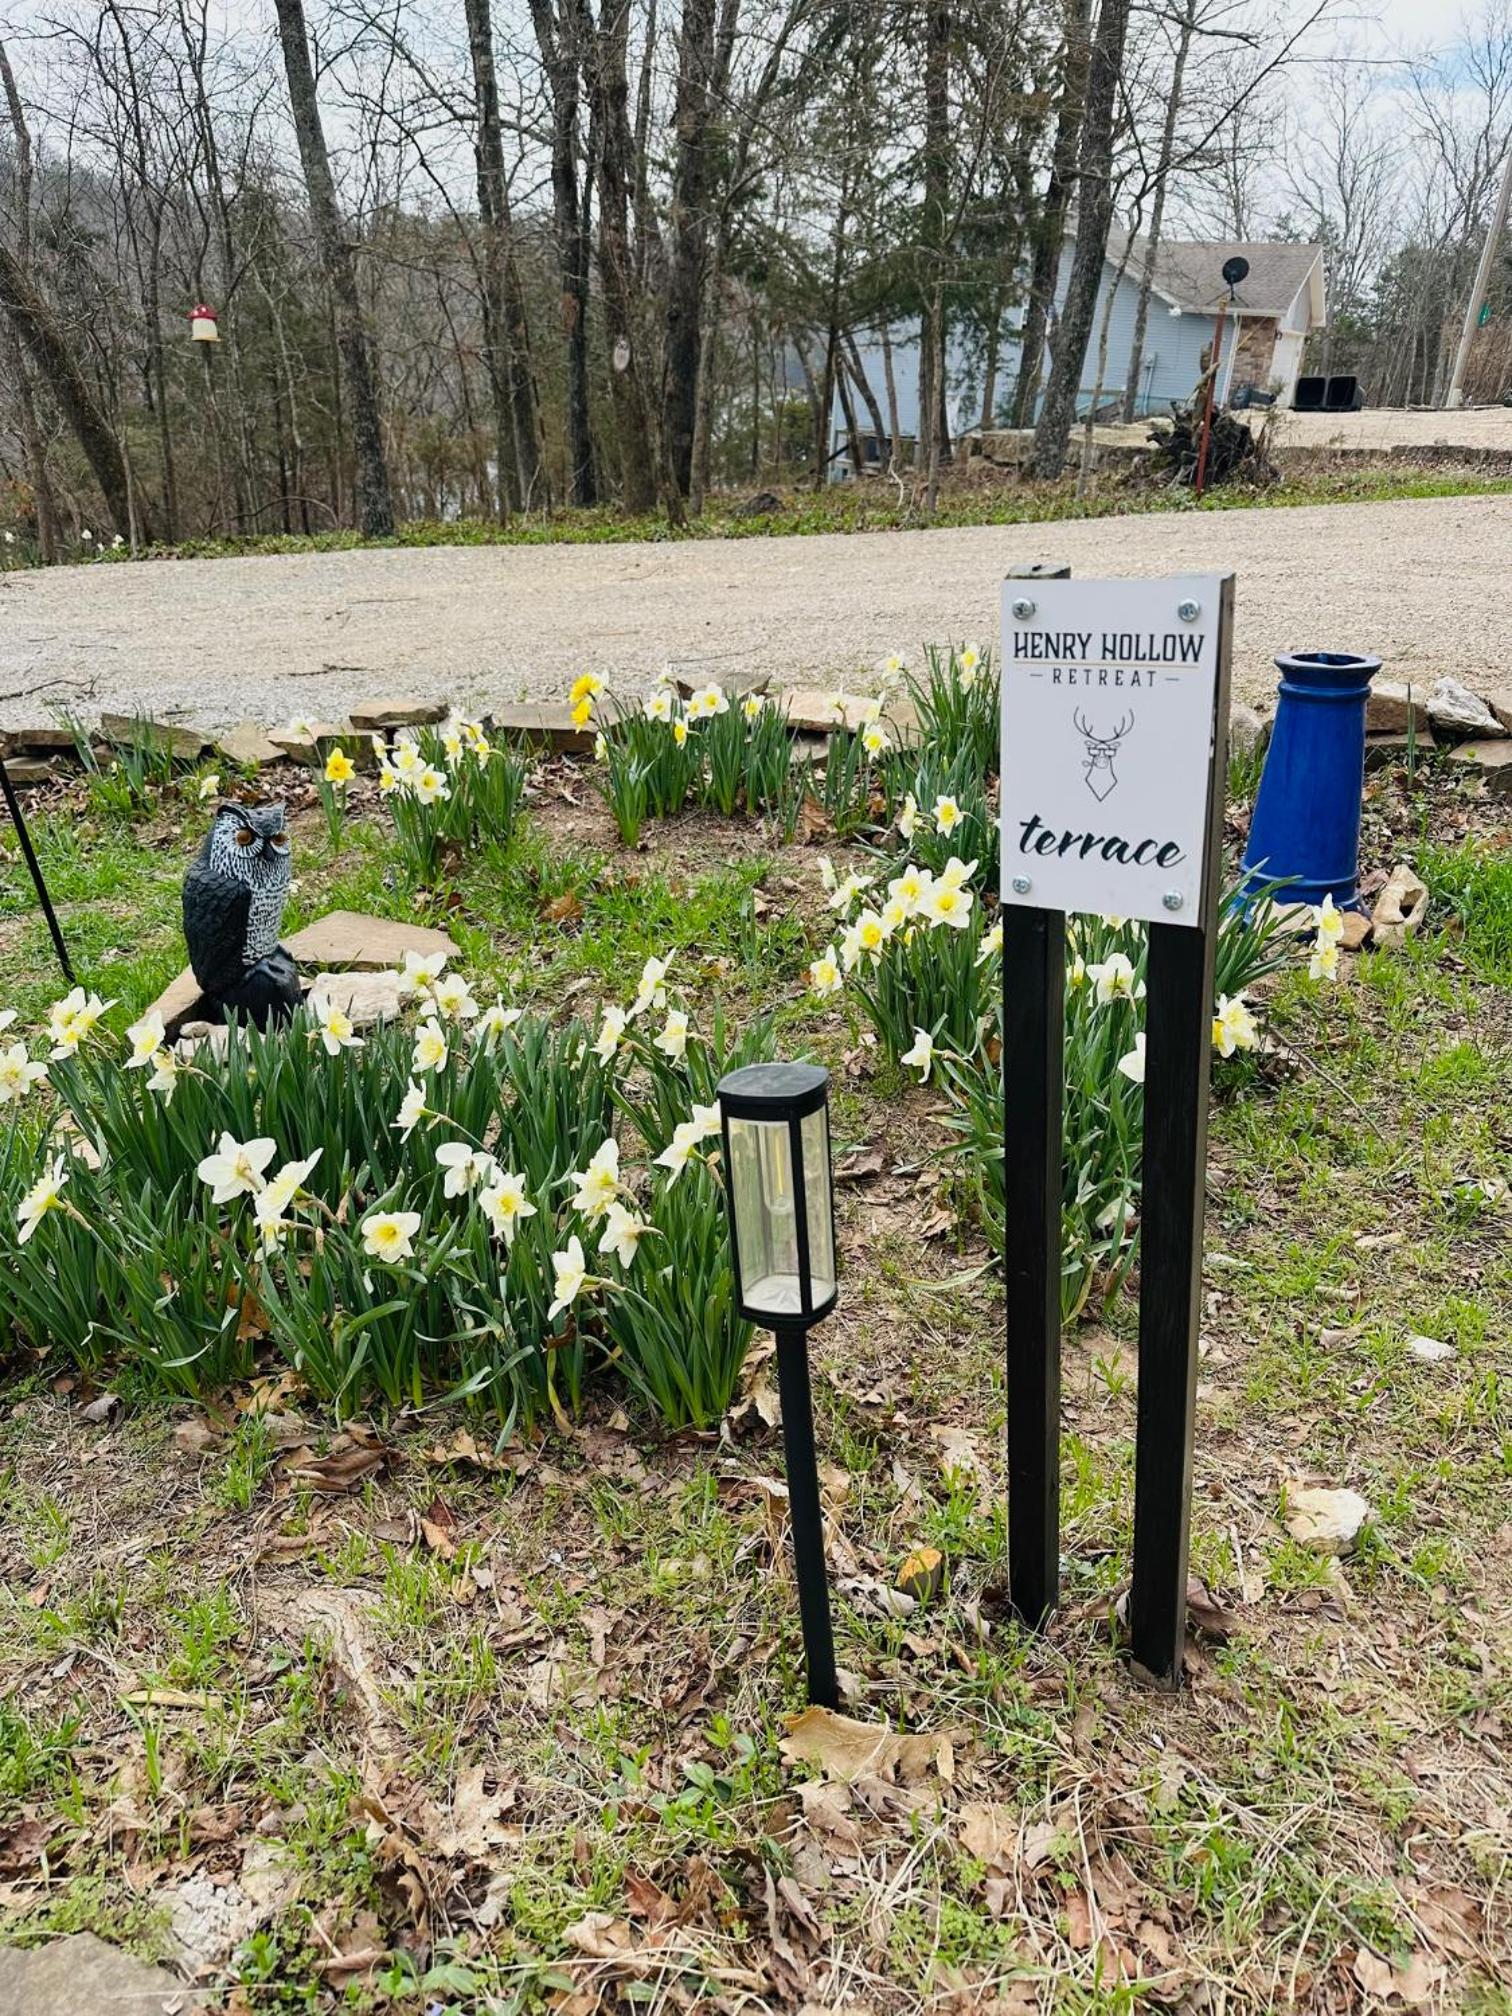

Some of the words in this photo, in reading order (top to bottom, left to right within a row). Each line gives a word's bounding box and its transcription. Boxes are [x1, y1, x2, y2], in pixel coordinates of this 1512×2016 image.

[1014, 632, 1092, 659] HENRY
[1102, 634, 1204, 662] HOLLOW
[1053, 668, 1156, 687] RETREAT
[1020, 814, 1186, 868] terrace
